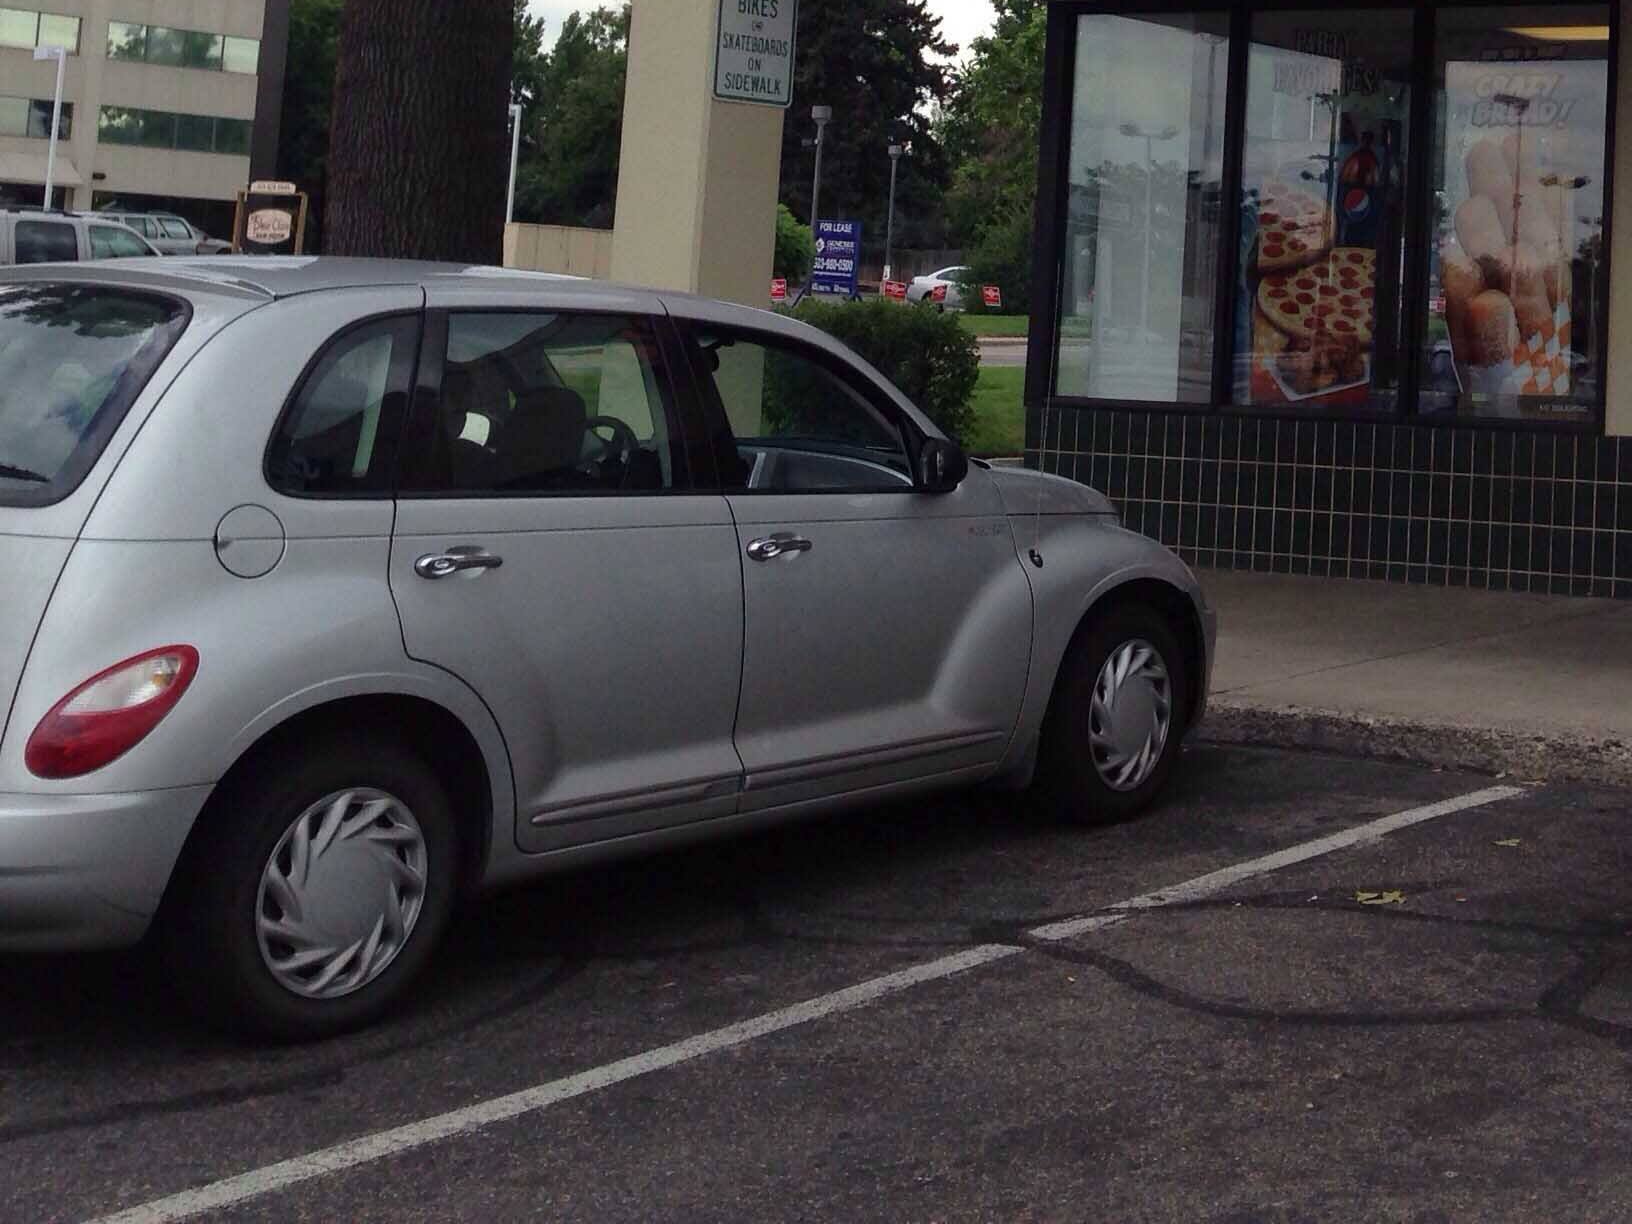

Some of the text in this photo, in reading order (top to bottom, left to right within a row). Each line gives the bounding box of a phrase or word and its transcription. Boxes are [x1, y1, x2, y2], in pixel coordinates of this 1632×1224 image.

[723, 32, 788, 58] SKATEBOARDS
[747, 57, 761, 72] ON
[724, 72, 781, 95] SIDEWALK
[1474, 72, 1562, 100] CRAZY
[820, 222, 853, 233] FOR LEASE
